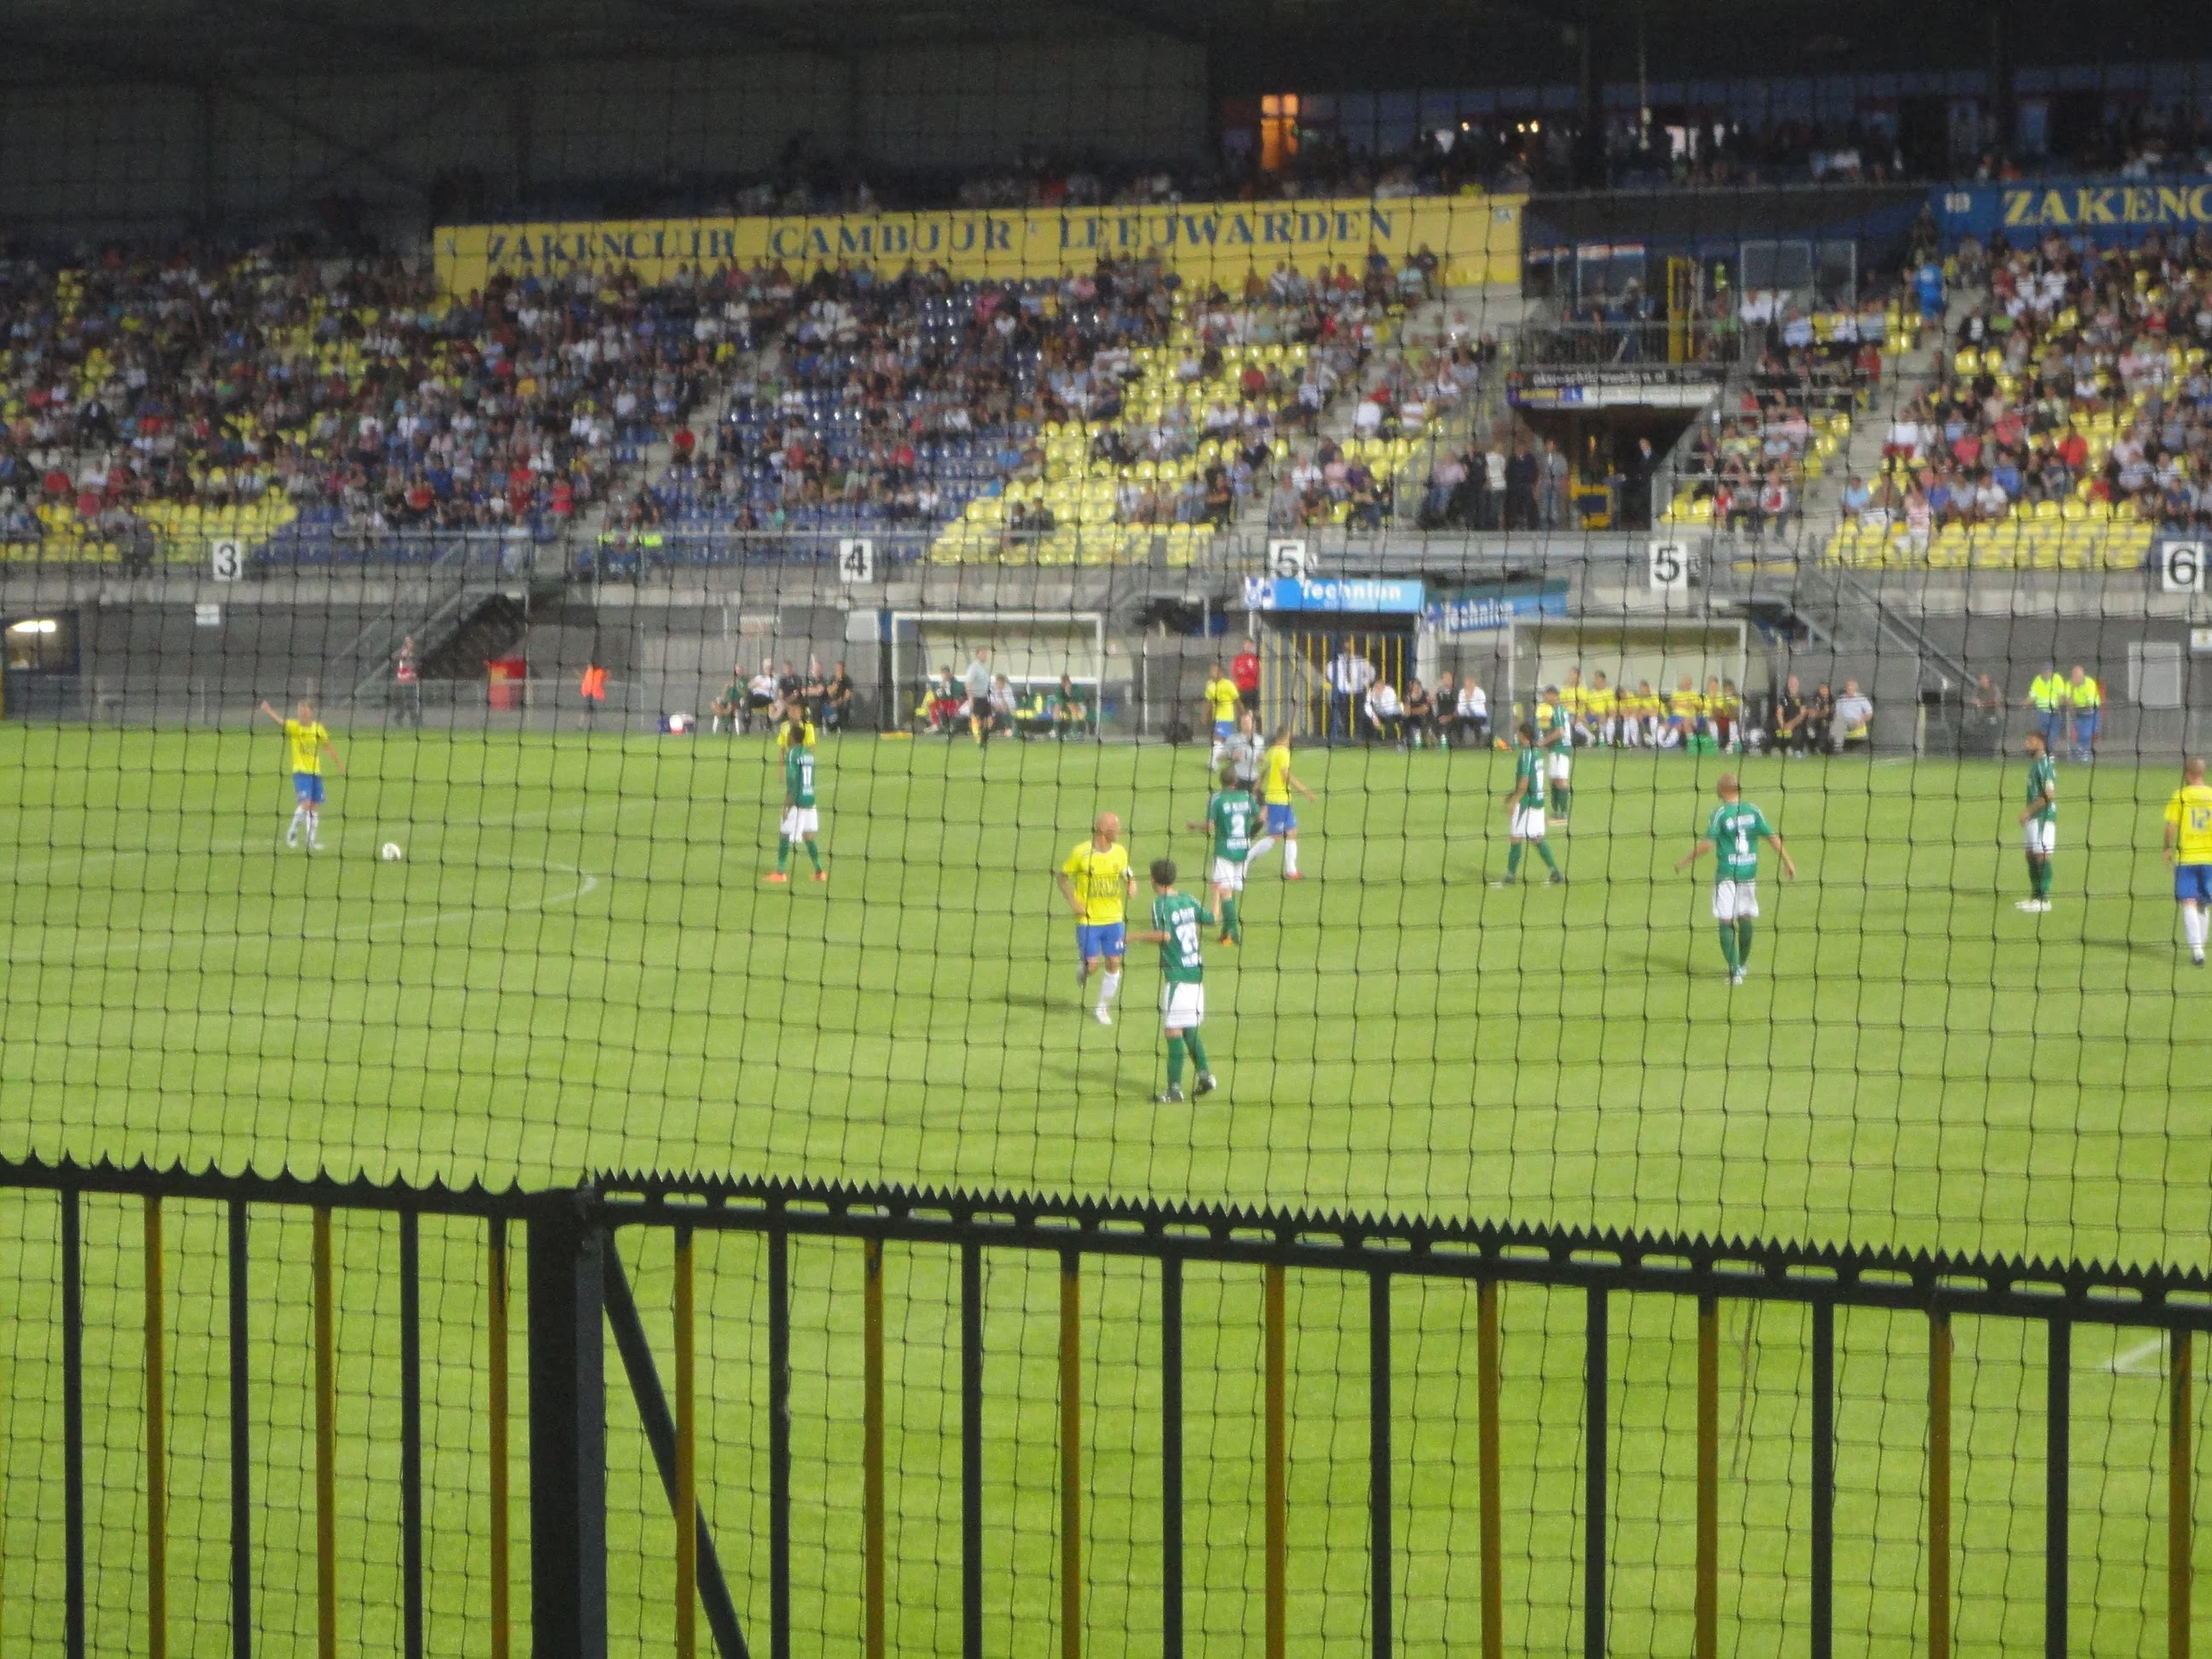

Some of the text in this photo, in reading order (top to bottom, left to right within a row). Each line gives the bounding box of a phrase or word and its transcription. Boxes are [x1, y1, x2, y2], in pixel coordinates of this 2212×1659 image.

[771, 218, 1011, 256] CAMBUUR
[1059, 210, 1396, 249] LEEUWARDEN
[218, 543, 237, 577] 3
[844, 544, 868, 577] 4
[1276, 544, 1301, 579] 5
[1655, 546, 1679, 582] 5
[2168, 549, 2197, 585] 6
